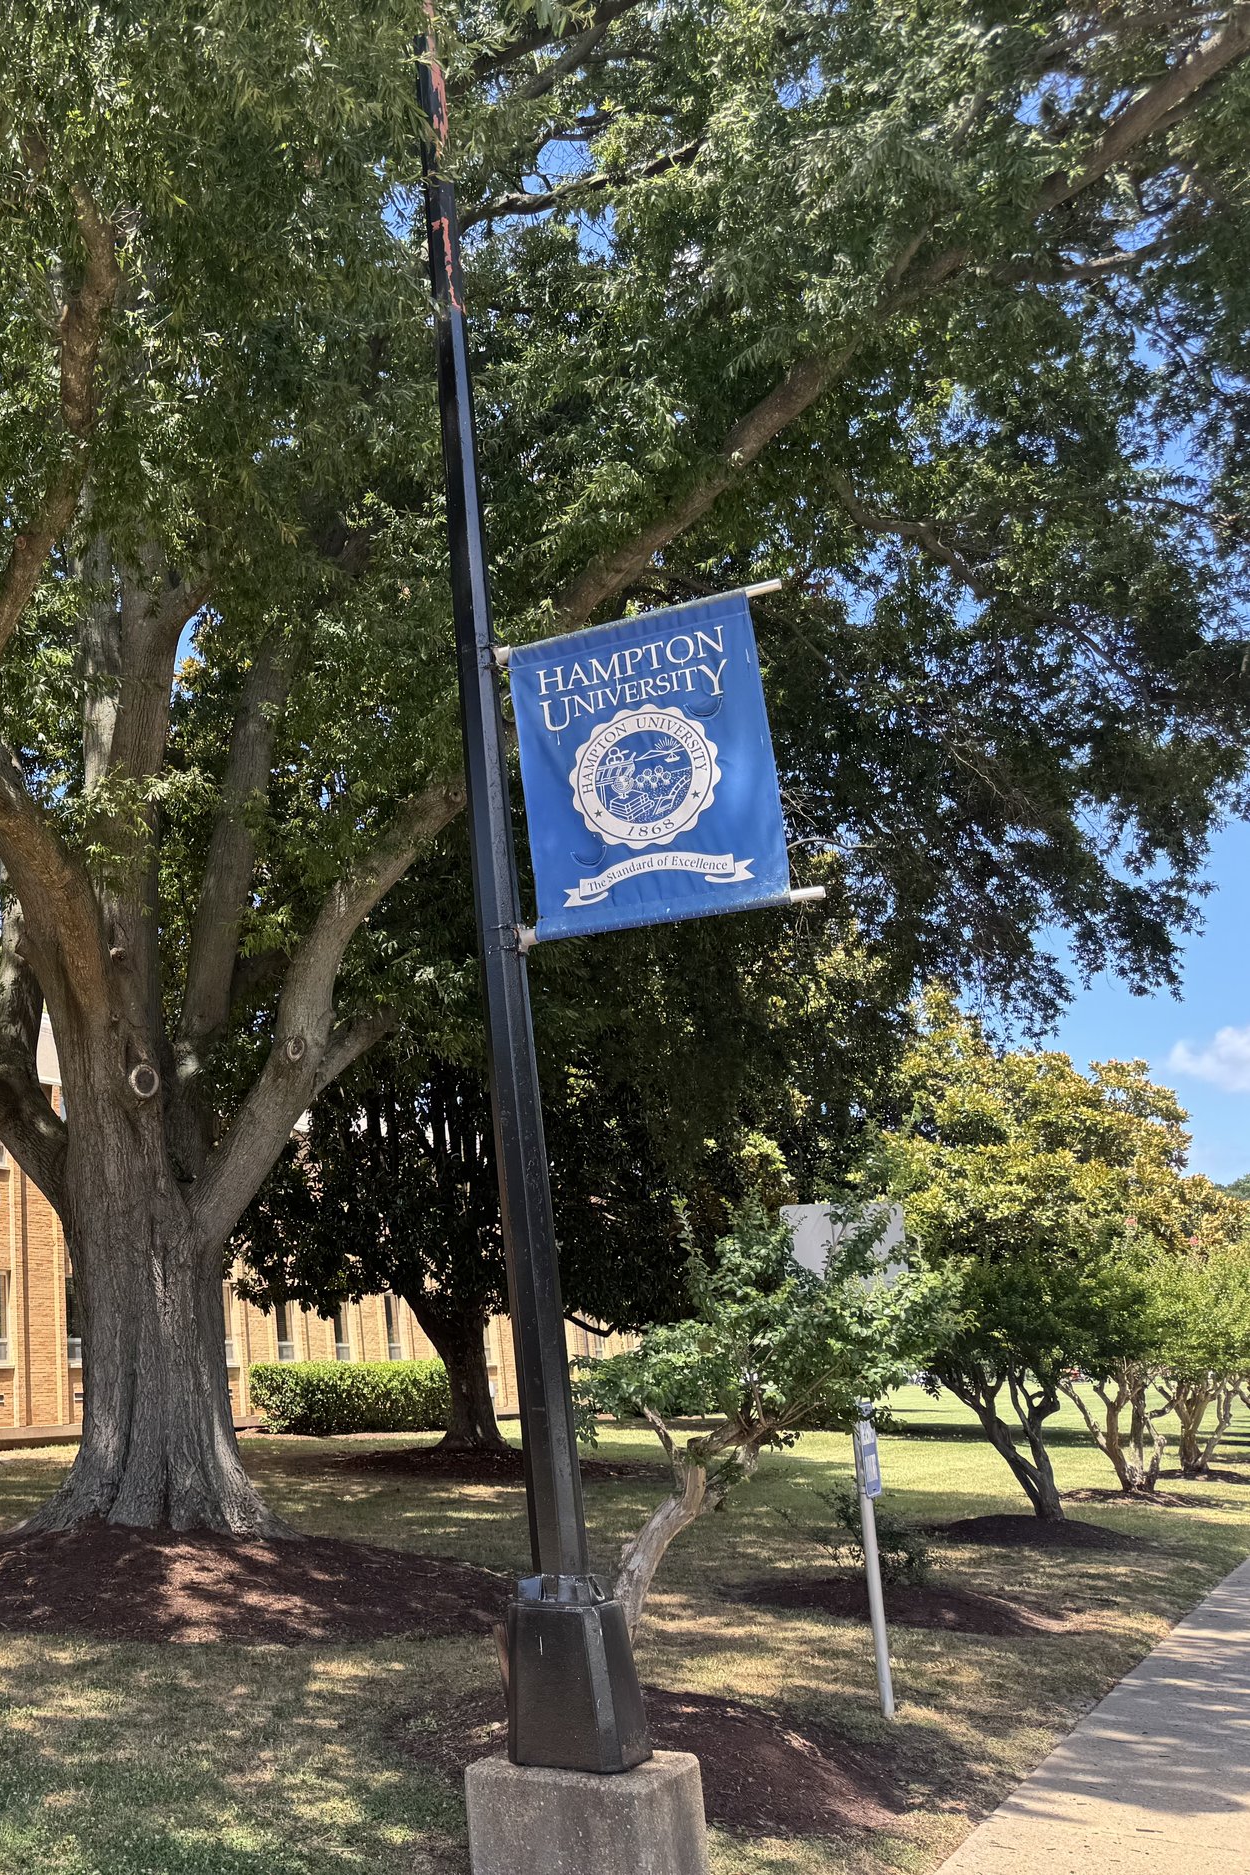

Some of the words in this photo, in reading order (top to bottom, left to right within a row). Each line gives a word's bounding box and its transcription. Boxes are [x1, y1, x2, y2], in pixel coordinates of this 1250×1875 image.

[536, 625, 724, 696] HAMPTON
[539, 659, 728, 732] UNIVERSITY
[582, 723, 627, 794] HAMPTON
[635, 716, 708, 772] UNIVERSITY
[626, 818, 675, 837] 1868
[587, 877, 607, 892] The
[606, 856, 654, 883] Standard
[657, 855, 669, 867] of
[671, 855, 728, 871] Excellence
